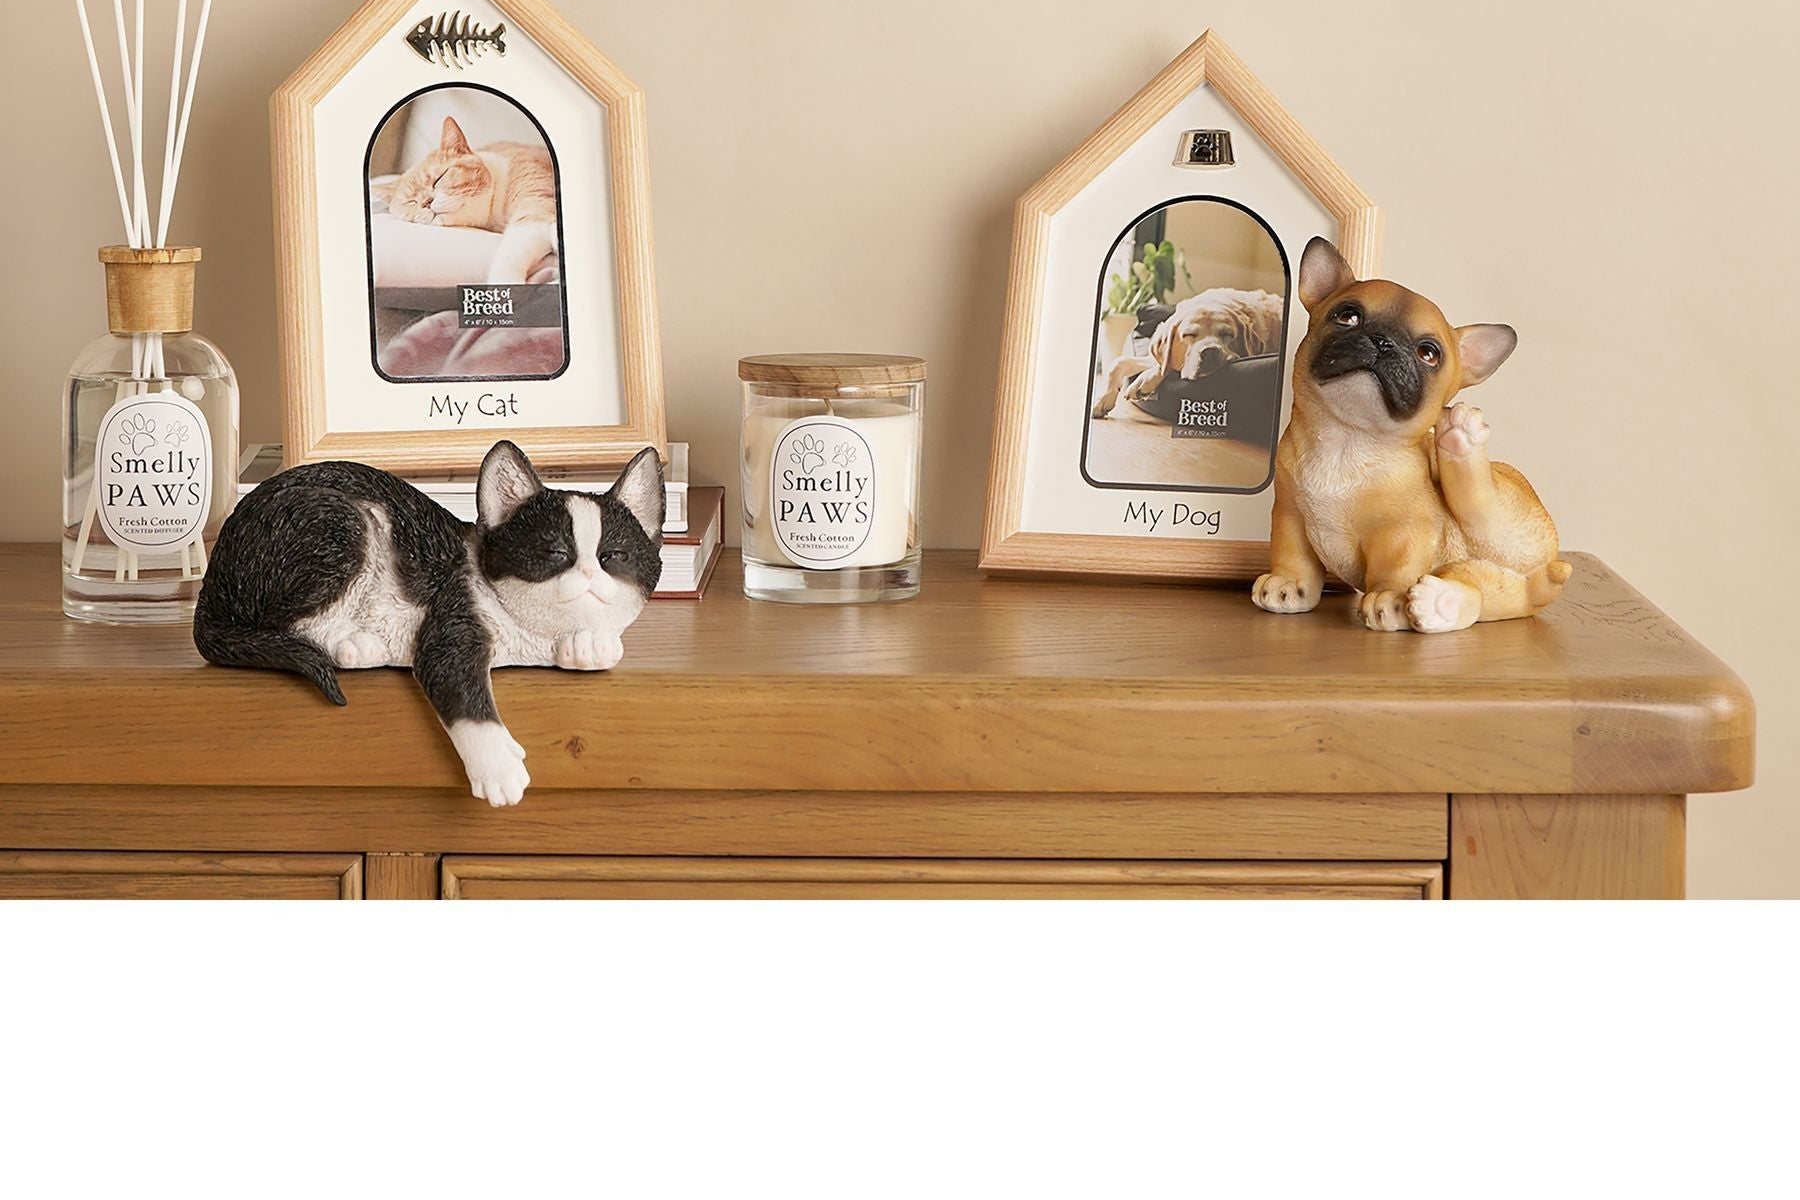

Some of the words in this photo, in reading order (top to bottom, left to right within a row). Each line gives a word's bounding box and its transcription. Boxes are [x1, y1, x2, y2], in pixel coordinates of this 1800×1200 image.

[463, 288, 501, 302] Best
[501, 288, 511, 299] of
[463, 300, 513, 315] Breed
[429, 395, 468, 424] My
[477, 393, 518, 417] Cat
[1181, 399, 1216, 413] Best
[1217, 400, 1227, 411] of
[1177, 411, 1228, 426] Breed
[110, 451, 201, 480] Smelly
[782, 469, 868, 499] Smelly
[107, 482, 201, 507] PAWS
[119, 517, 148, 526] Fresh
[150, 517, 188, 526] Cotton
[779, 499, 868, 524] PAWS
[1123, 501, 1164, 532] My
[1172, 503, 1221, 535] Dog
[790, 532, 816, 542] Fresh
[818, 533, 855, 542] Cotton
